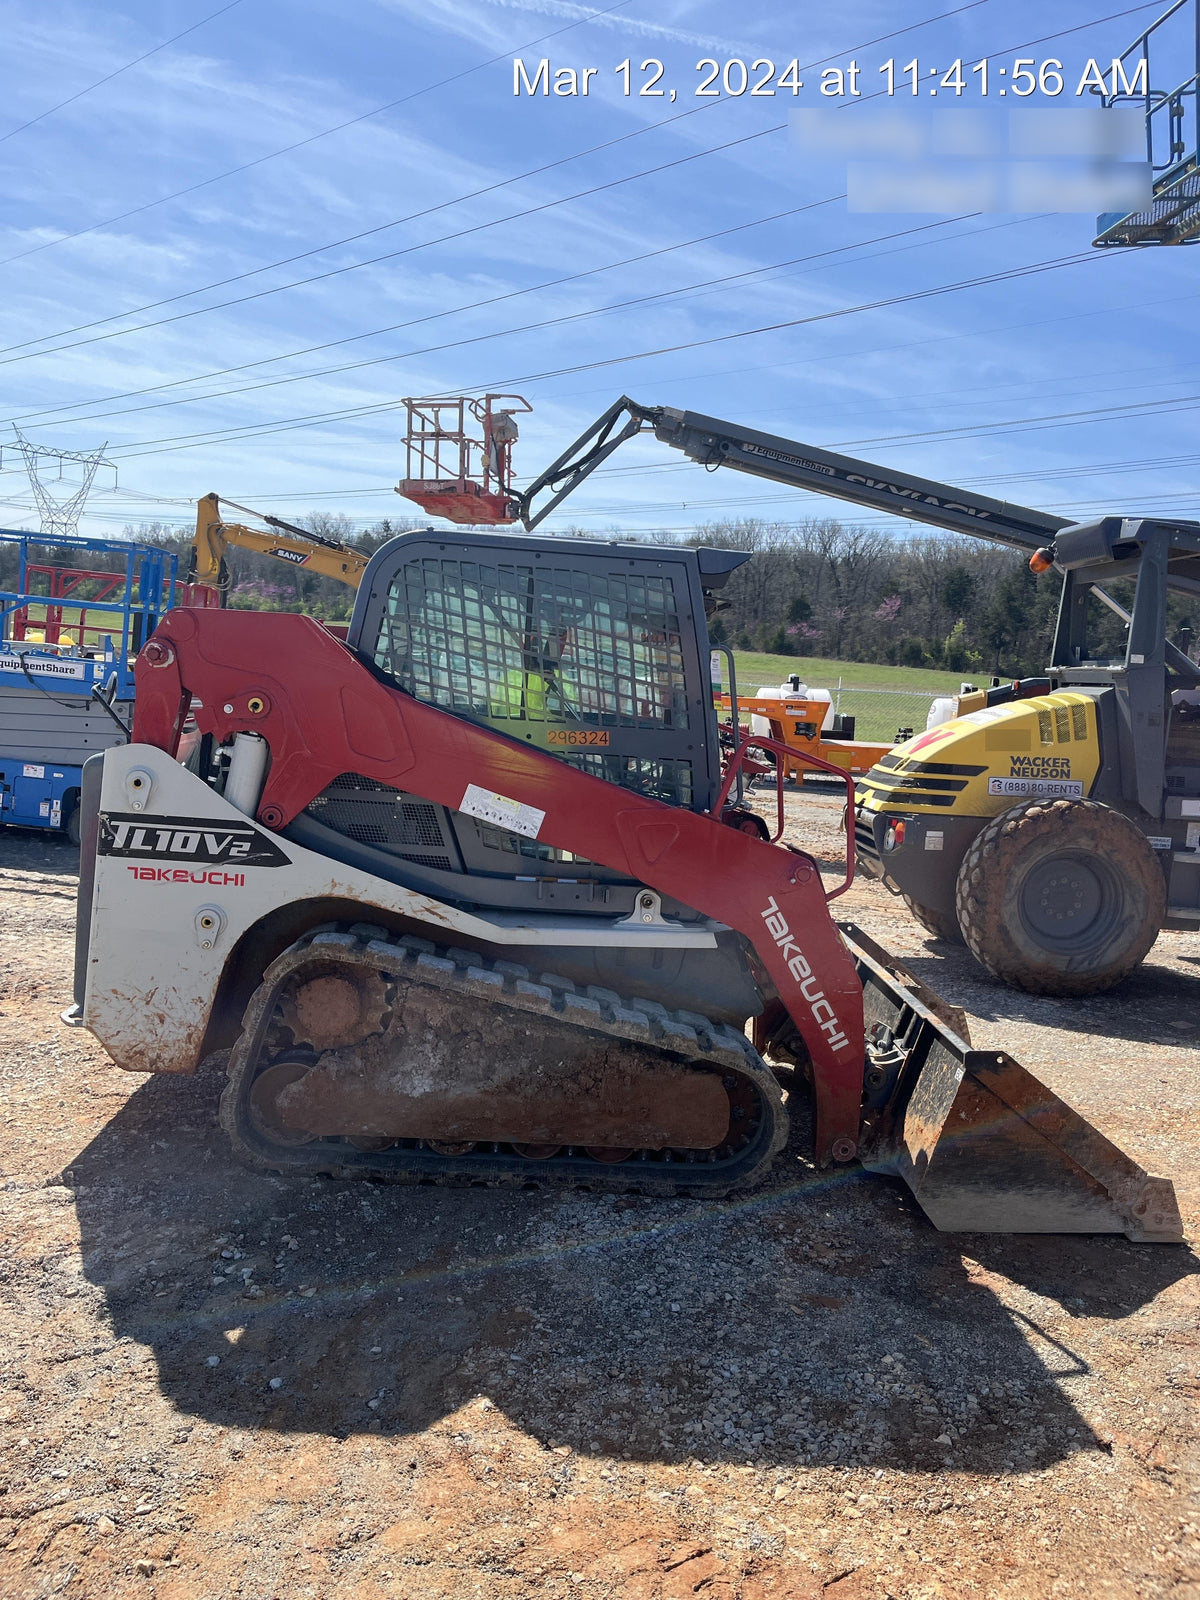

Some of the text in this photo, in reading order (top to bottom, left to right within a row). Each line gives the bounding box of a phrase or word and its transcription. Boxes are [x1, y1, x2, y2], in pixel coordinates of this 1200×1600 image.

[757, 447, 831, 475] EquipmentShare
[277, 549, 303, 562] SANY
[548, 730, 609, 745] 296324
[1009, 755, 1071, 769] WACKER
[1009, 766, 1071, 779] NEUSON
